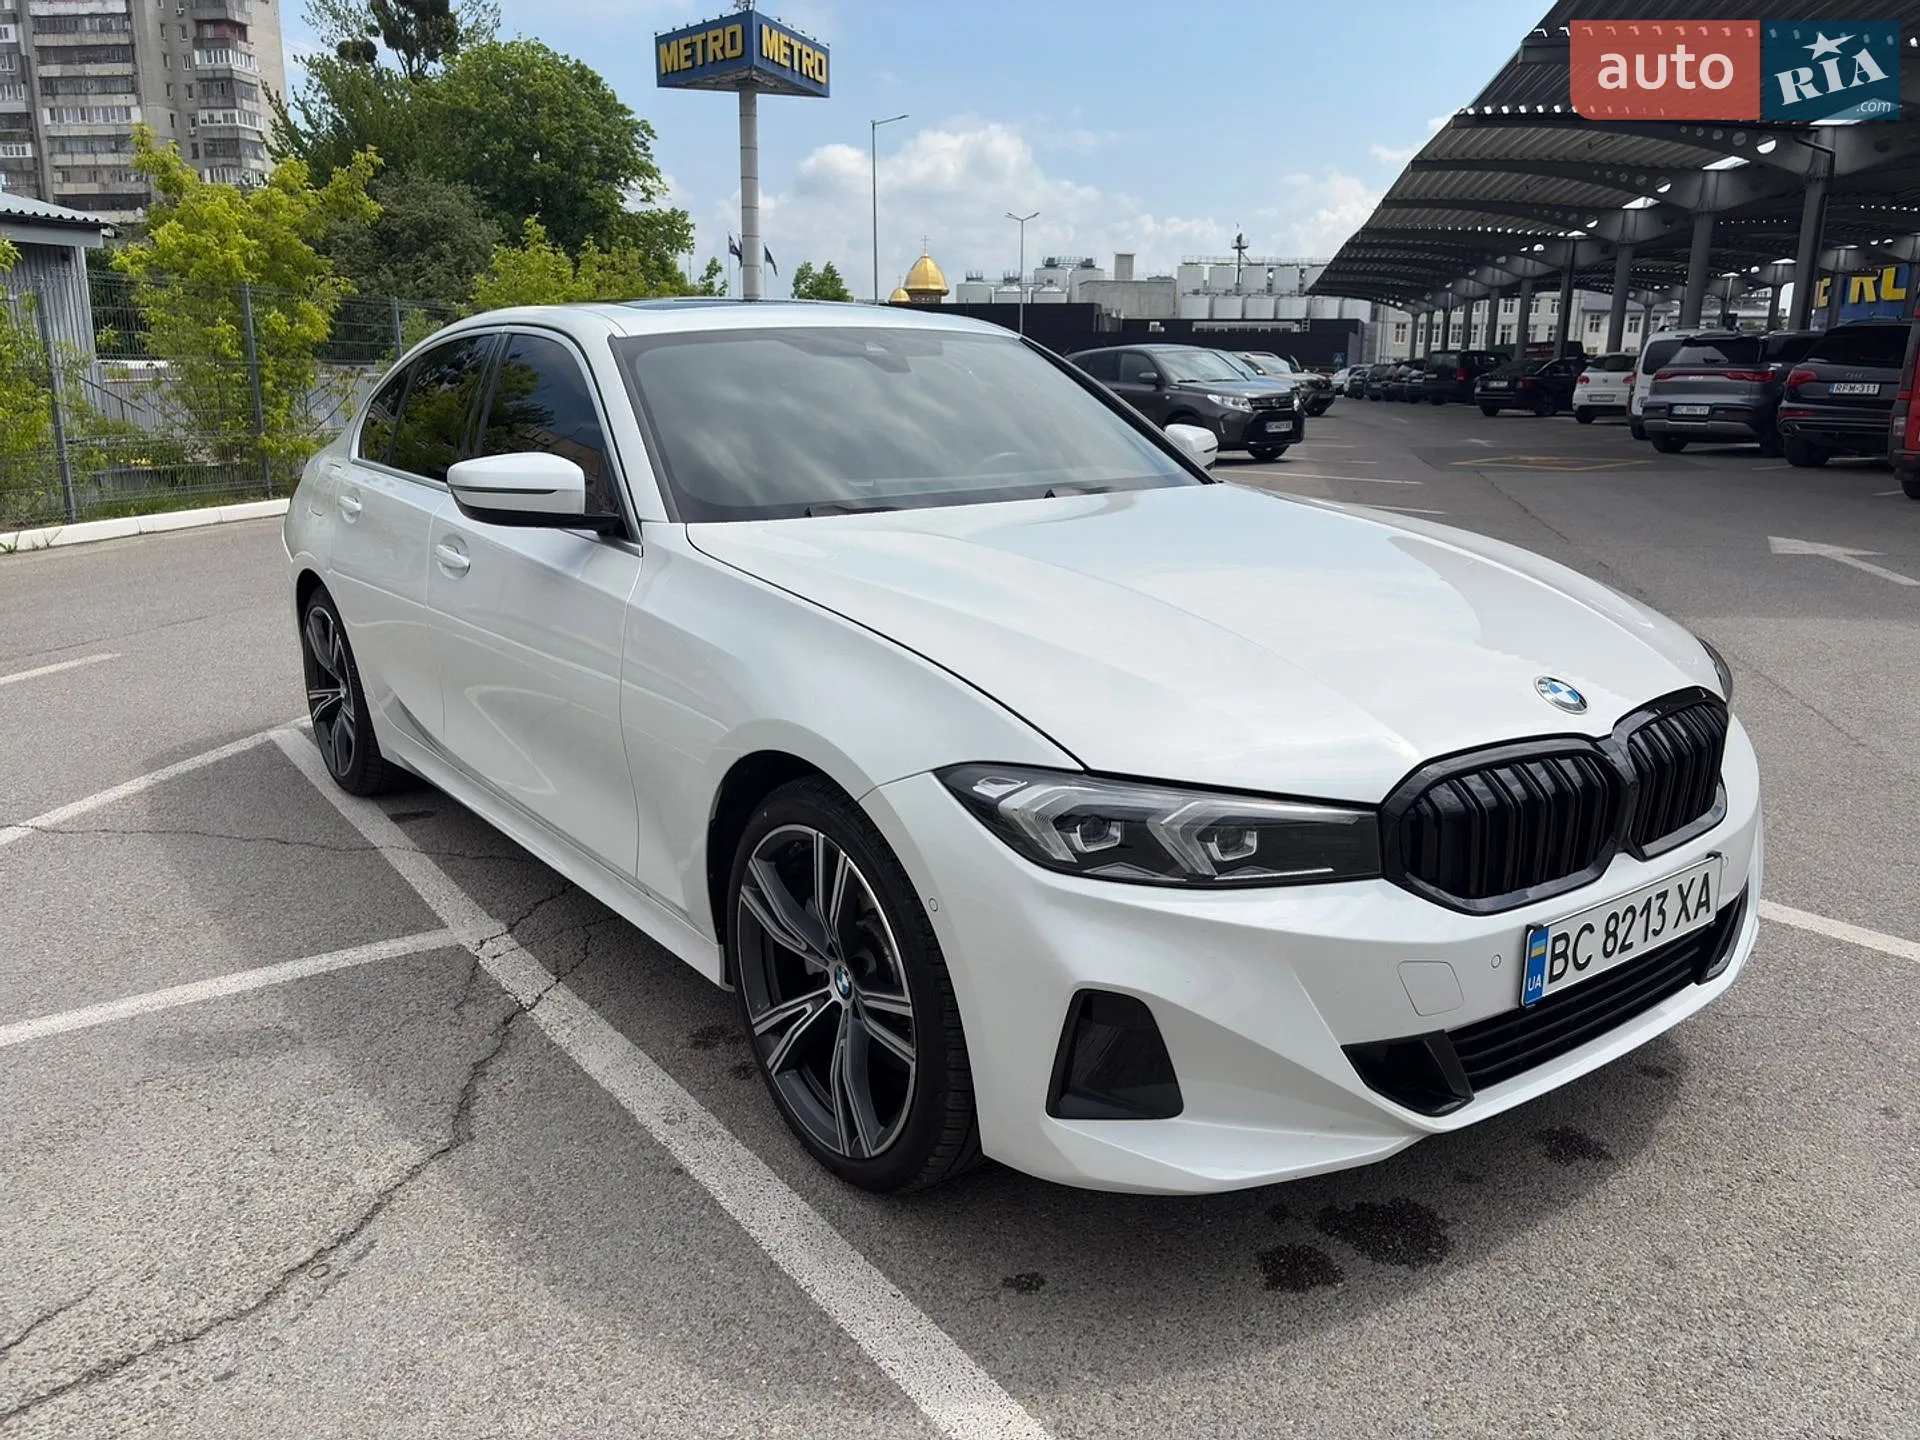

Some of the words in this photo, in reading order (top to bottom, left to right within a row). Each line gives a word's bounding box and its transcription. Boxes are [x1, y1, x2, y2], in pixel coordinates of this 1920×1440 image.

[659, 23, 743, 75] METRO
[761, 23, 827, 85] METRO
[1549, 922, 1595, 984] BC
[1602, 889, 1669, 958] 8213
[1674, 872, 1711, 928] XA
[1528, 973, 1542, 991] UA
